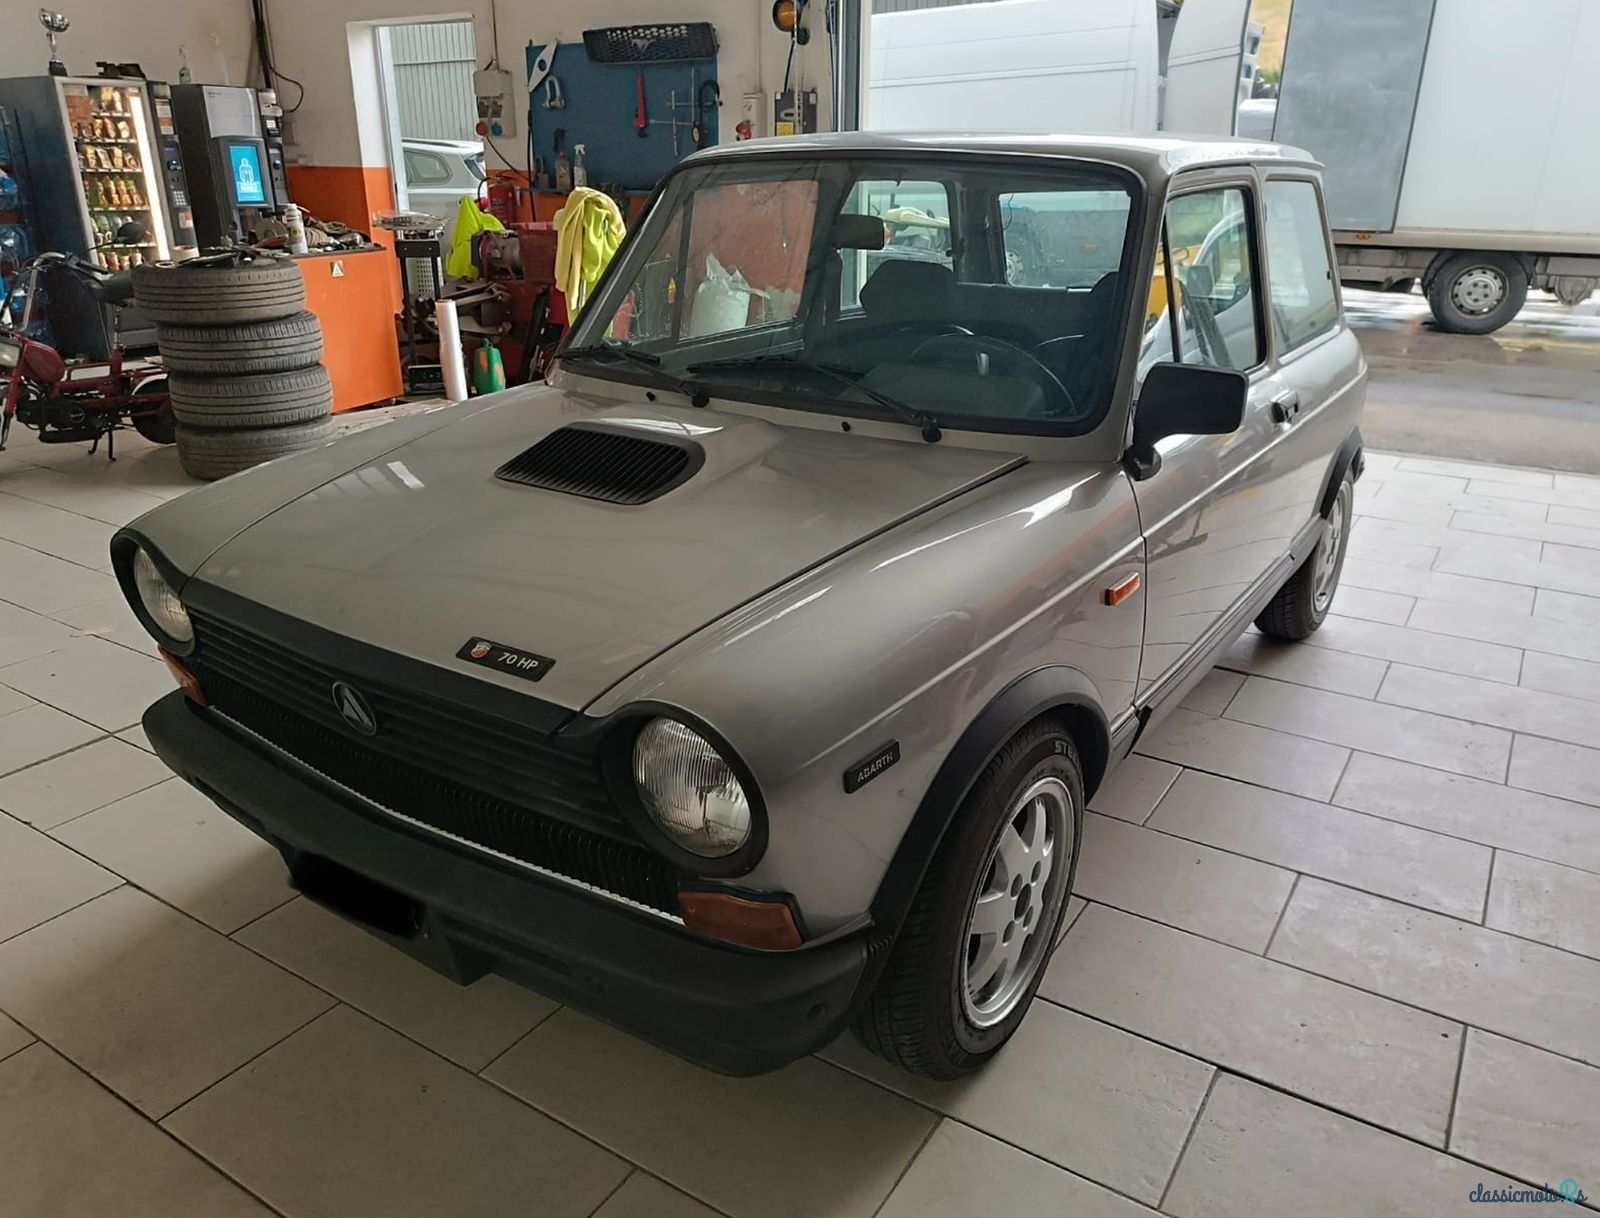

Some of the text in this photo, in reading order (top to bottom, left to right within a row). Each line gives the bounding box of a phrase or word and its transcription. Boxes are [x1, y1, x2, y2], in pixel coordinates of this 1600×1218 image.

[498, 652, 538, 670] 70 HP
[857, 752, 893, 783] ABARTH
